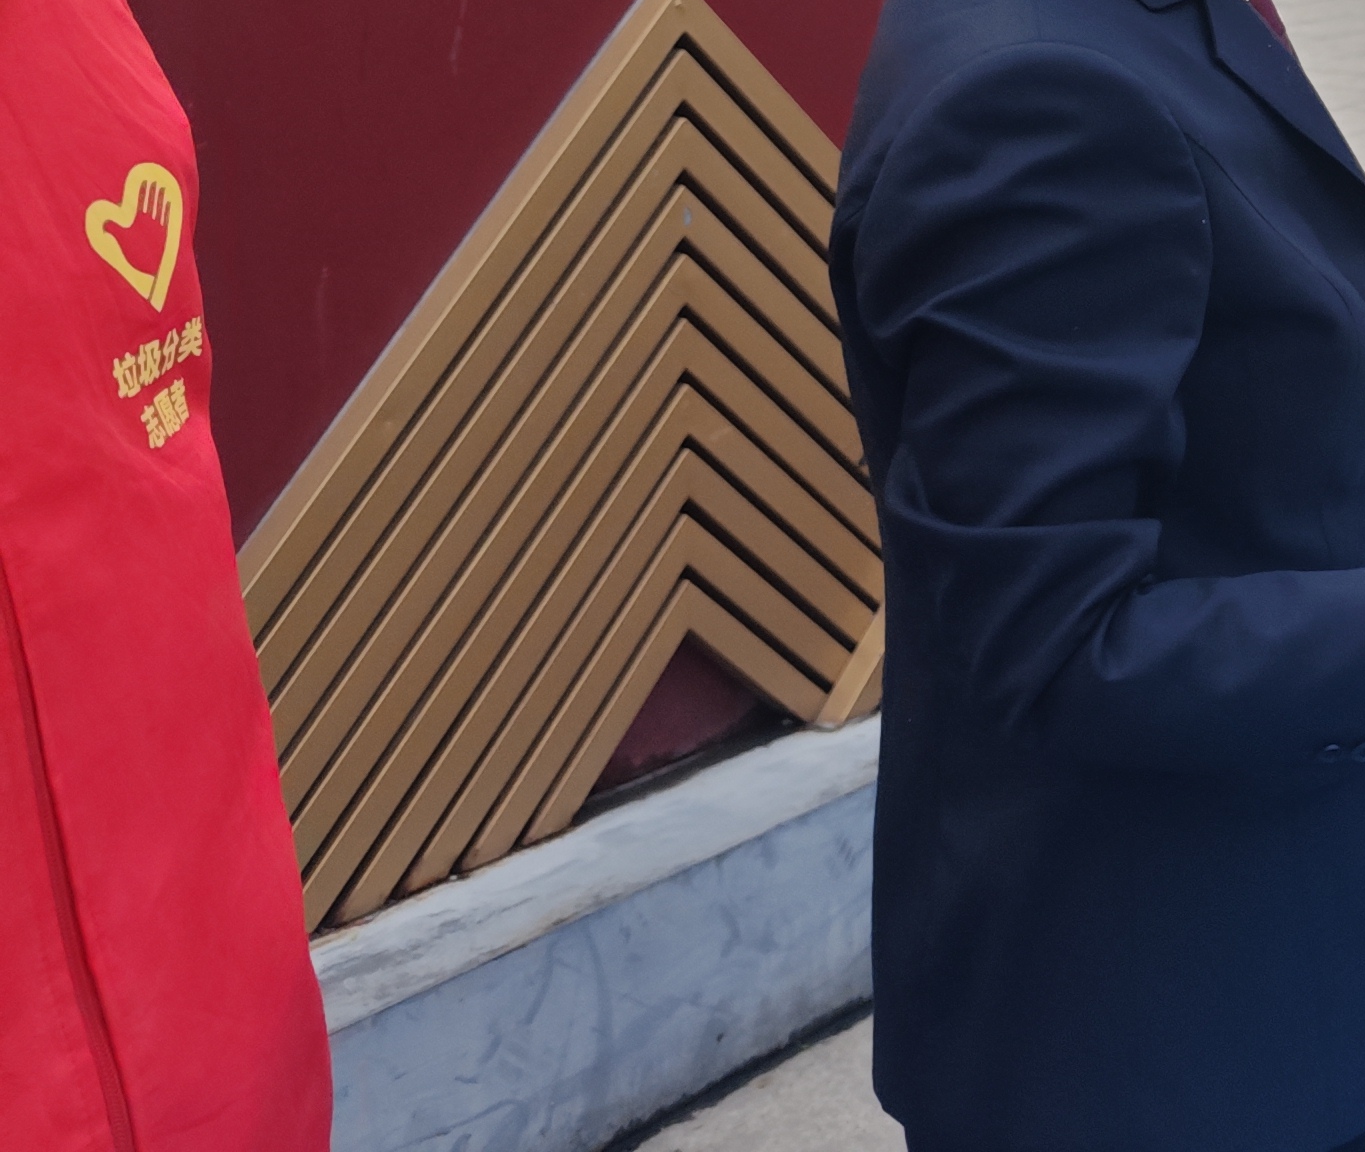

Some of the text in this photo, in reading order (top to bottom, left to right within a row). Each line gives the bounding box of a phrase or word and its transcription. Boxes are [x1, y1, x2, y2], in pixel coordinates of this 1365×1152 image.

[111, 316, 203, 398] 垃圾分类
[140, 377, 190, 449] 志愿者
